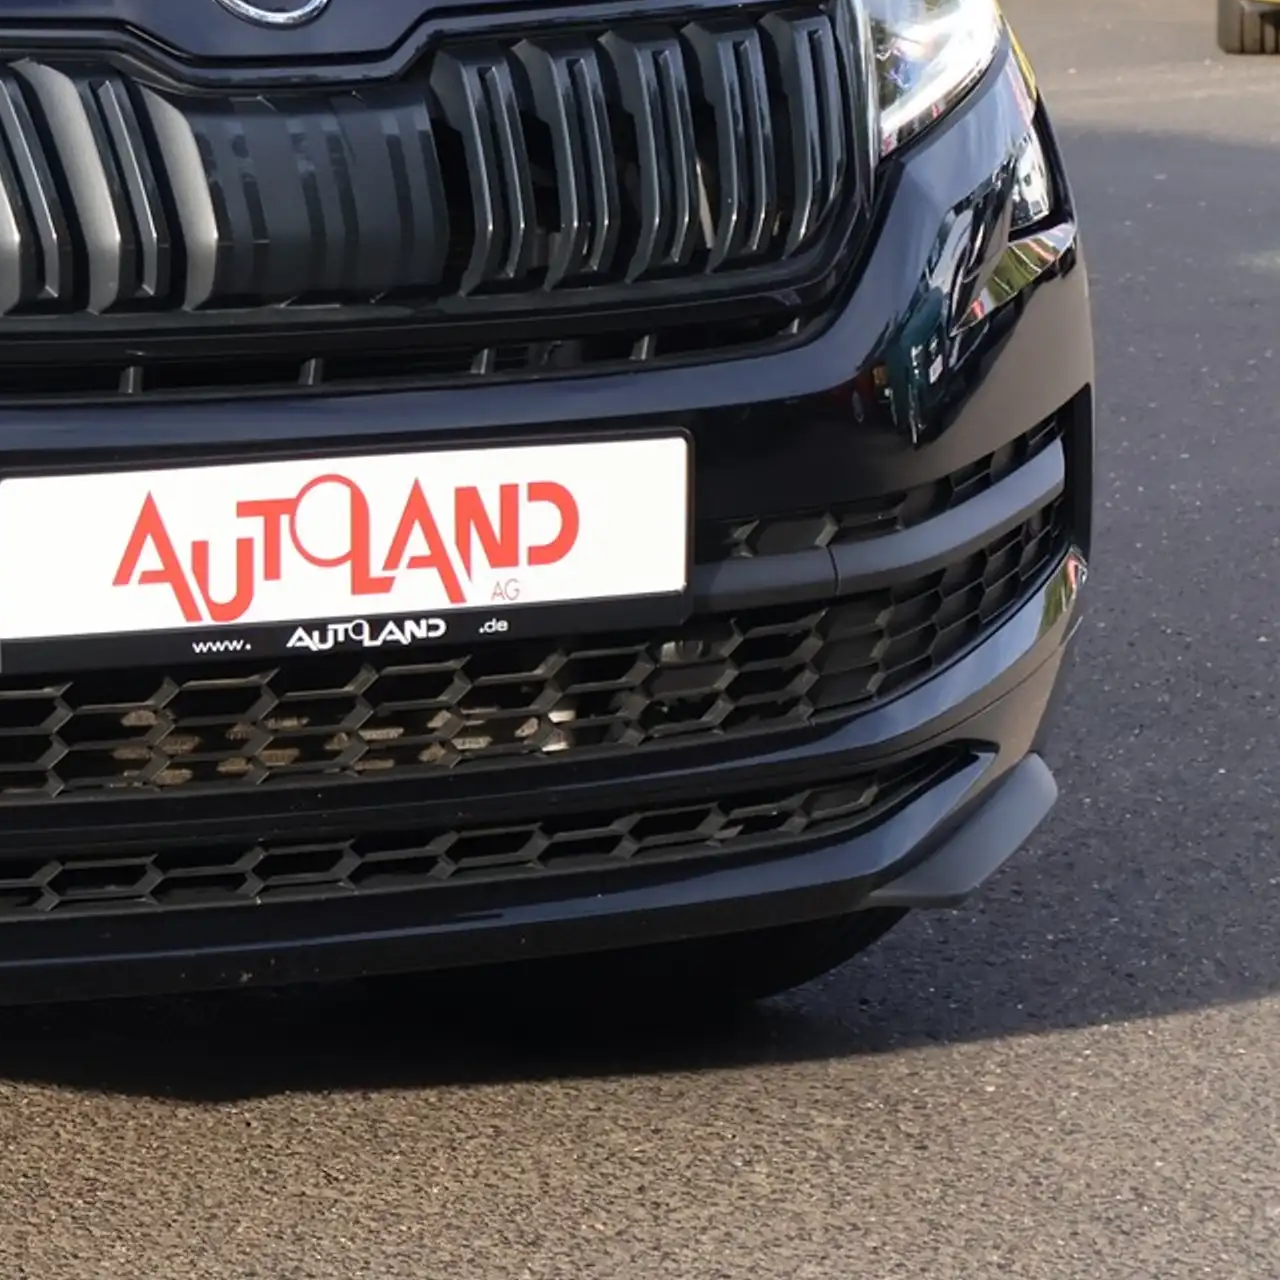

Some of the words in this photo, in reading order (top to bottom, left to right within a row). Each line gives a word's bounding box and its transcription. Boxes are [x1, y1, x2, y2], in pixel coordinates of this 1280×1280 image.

[111, 472, 580, 624] AUTOLAND
[490, 578, 521, 602] AG
[192, 637, 252, 654] www.
[285, 617, 447, 652] AUTOLAND
[478, 617, 509, 635] .de
